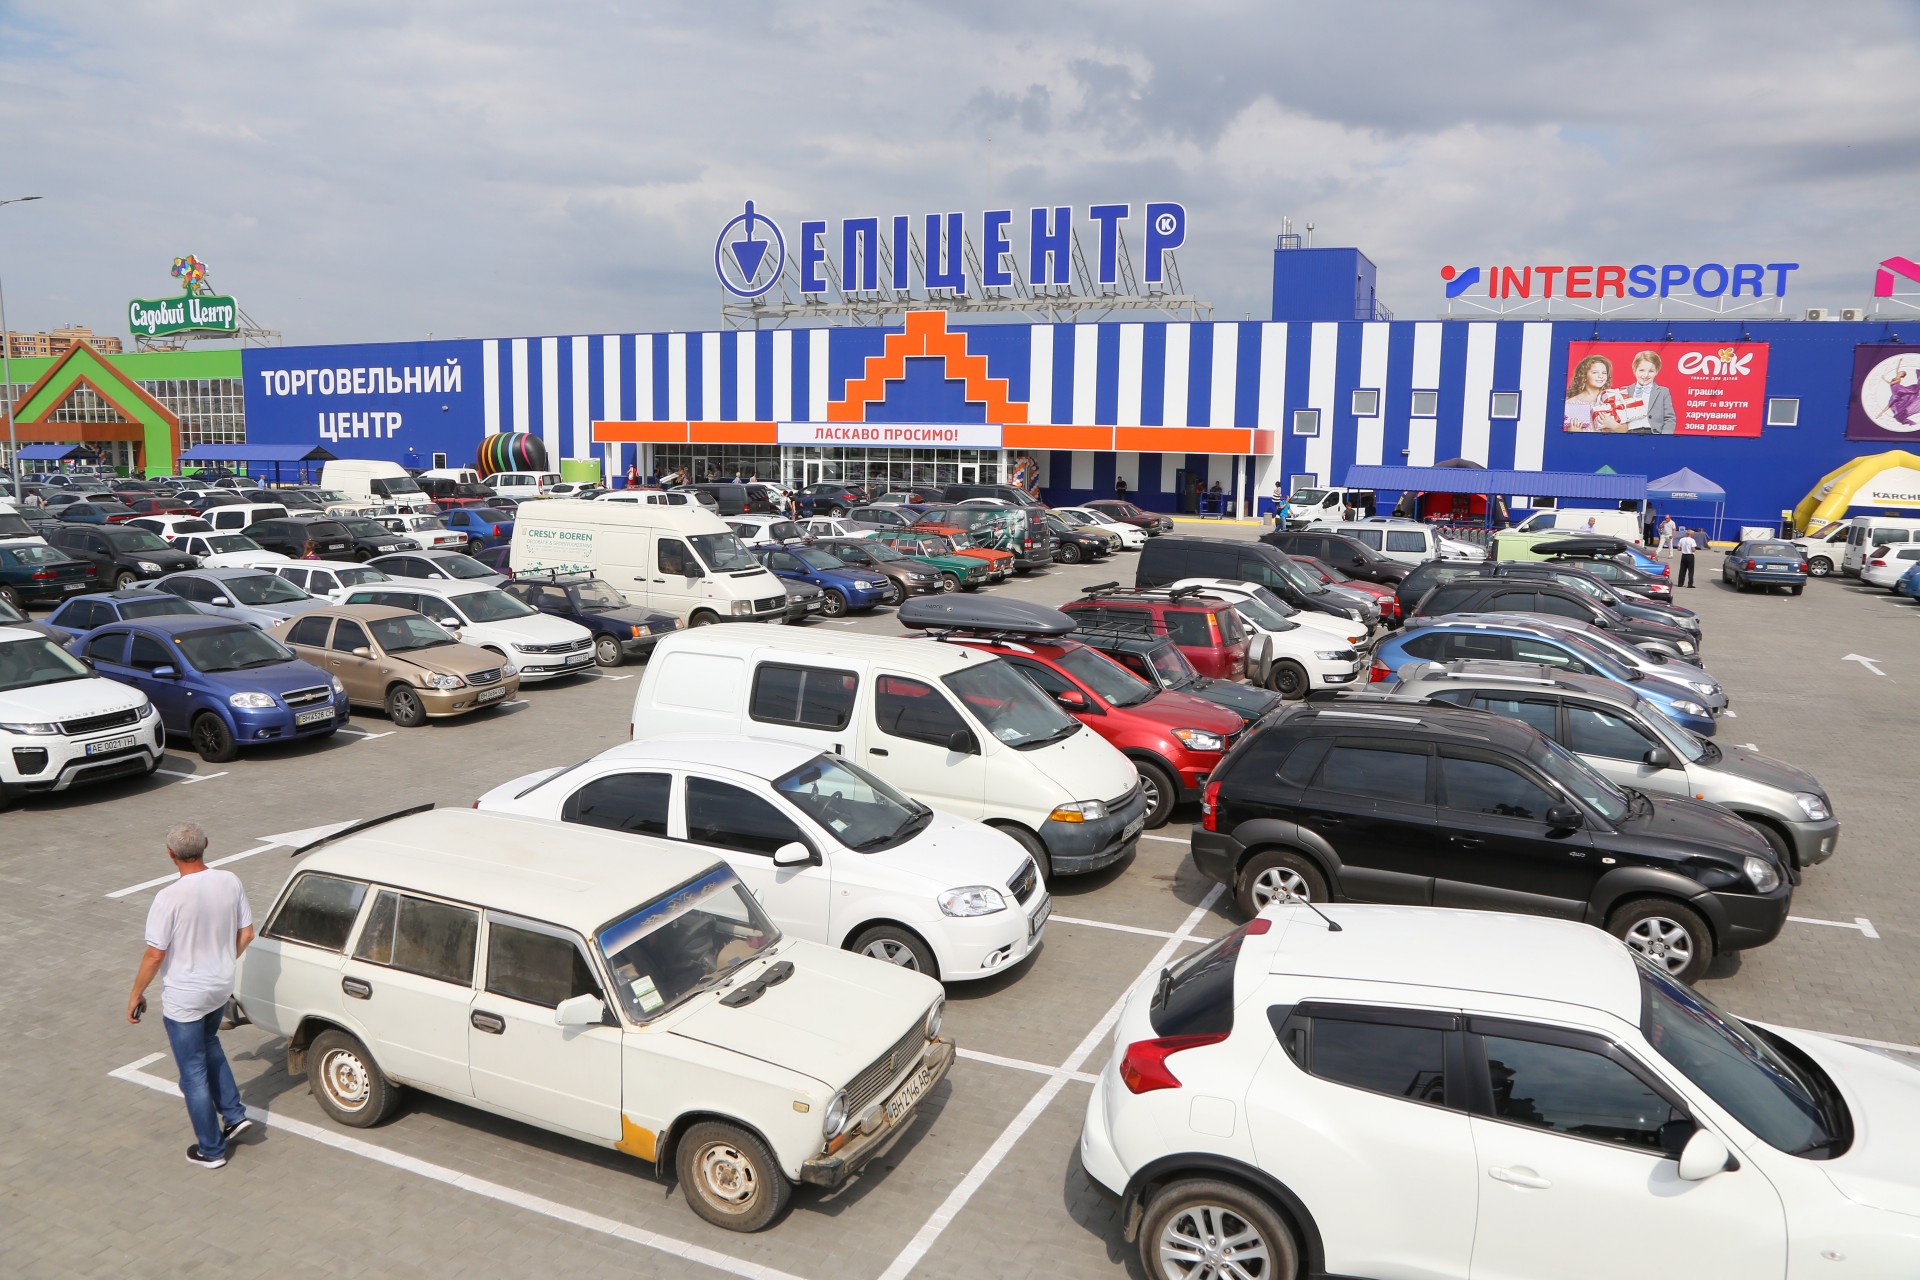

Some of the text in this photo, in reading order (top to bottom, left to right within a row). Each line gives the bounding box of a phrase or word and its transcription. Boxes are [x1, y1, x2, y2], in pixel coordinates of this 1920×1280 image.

[800, 202, 1187, 296] ЕПІЦЕНТР
[1488, 262, 1800, 299] INTERSPORT
[130, 298, 233, 334] Садовий Центр
[260, 357, 462, 396] ТОРГОВЕЛЬНИЙ
[1687, 386, 1724, 397] іграшки
[1686, 399, 1708, 408] одяг
[1718, 400, 1749, 410] взуття
[1685, 411, 1737, 420] харчування
[318, 411, 403, 443] ЦЕНТР
[814, 427, 959, 442] ЛАСКАВО ПРОСИМО!
[1706, 423, 1737, 432] розваг
[528, 529, 593, 542] CRESLY BOEREN
[58, 703, 134, 720] RANGE ROVER
[302, 715, 310, 723] BH
[92, 737, 133, 753] AE 0021 IH
[891, 1069, 930, 1118] BH 2146 AB
